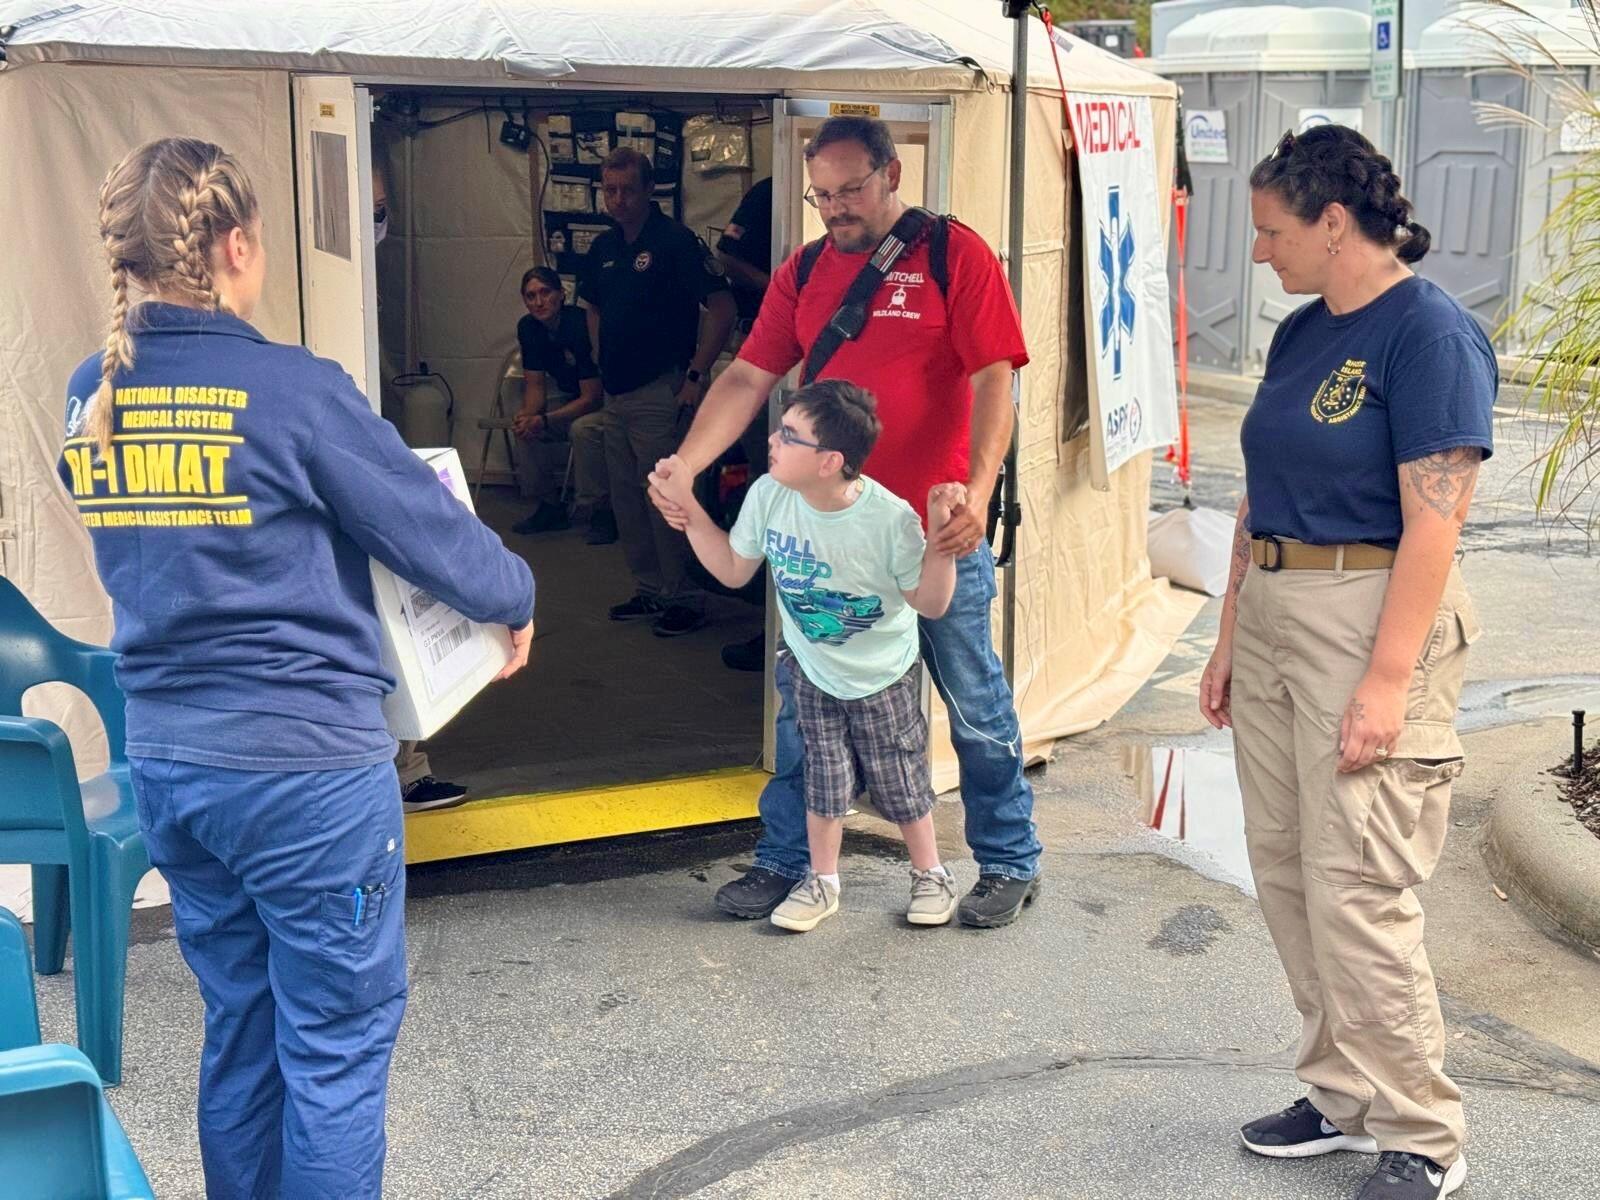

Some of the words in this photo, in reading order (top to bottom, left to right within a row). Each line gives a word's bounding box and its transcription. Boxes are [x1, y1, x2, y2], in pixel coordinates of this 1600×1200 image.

[1075, 102, 1140, 154] MEDICAL
[901, 310, 921, 320] CREW
[1340, 366, 1363, 375] ISLAND
[1345, 359, 1367, 368] RHODE
[115, 387, 173, 406] NATIONAL
[174, 387, 248, 408] DISASTER
[122, 410, 174, 429] MEDICAL
[174, 411, 234, 431] SYSTEM
[122, 443, 230, 494] DMAT
[102, 510, 145, 527] MEDICAL
[145, 509, 214, 526] ASSISTANCE
[213, 507, 252, 525] TEAM
[766, 528, 816, 559] FULL
[764, 545, 832, 579] SPEED
